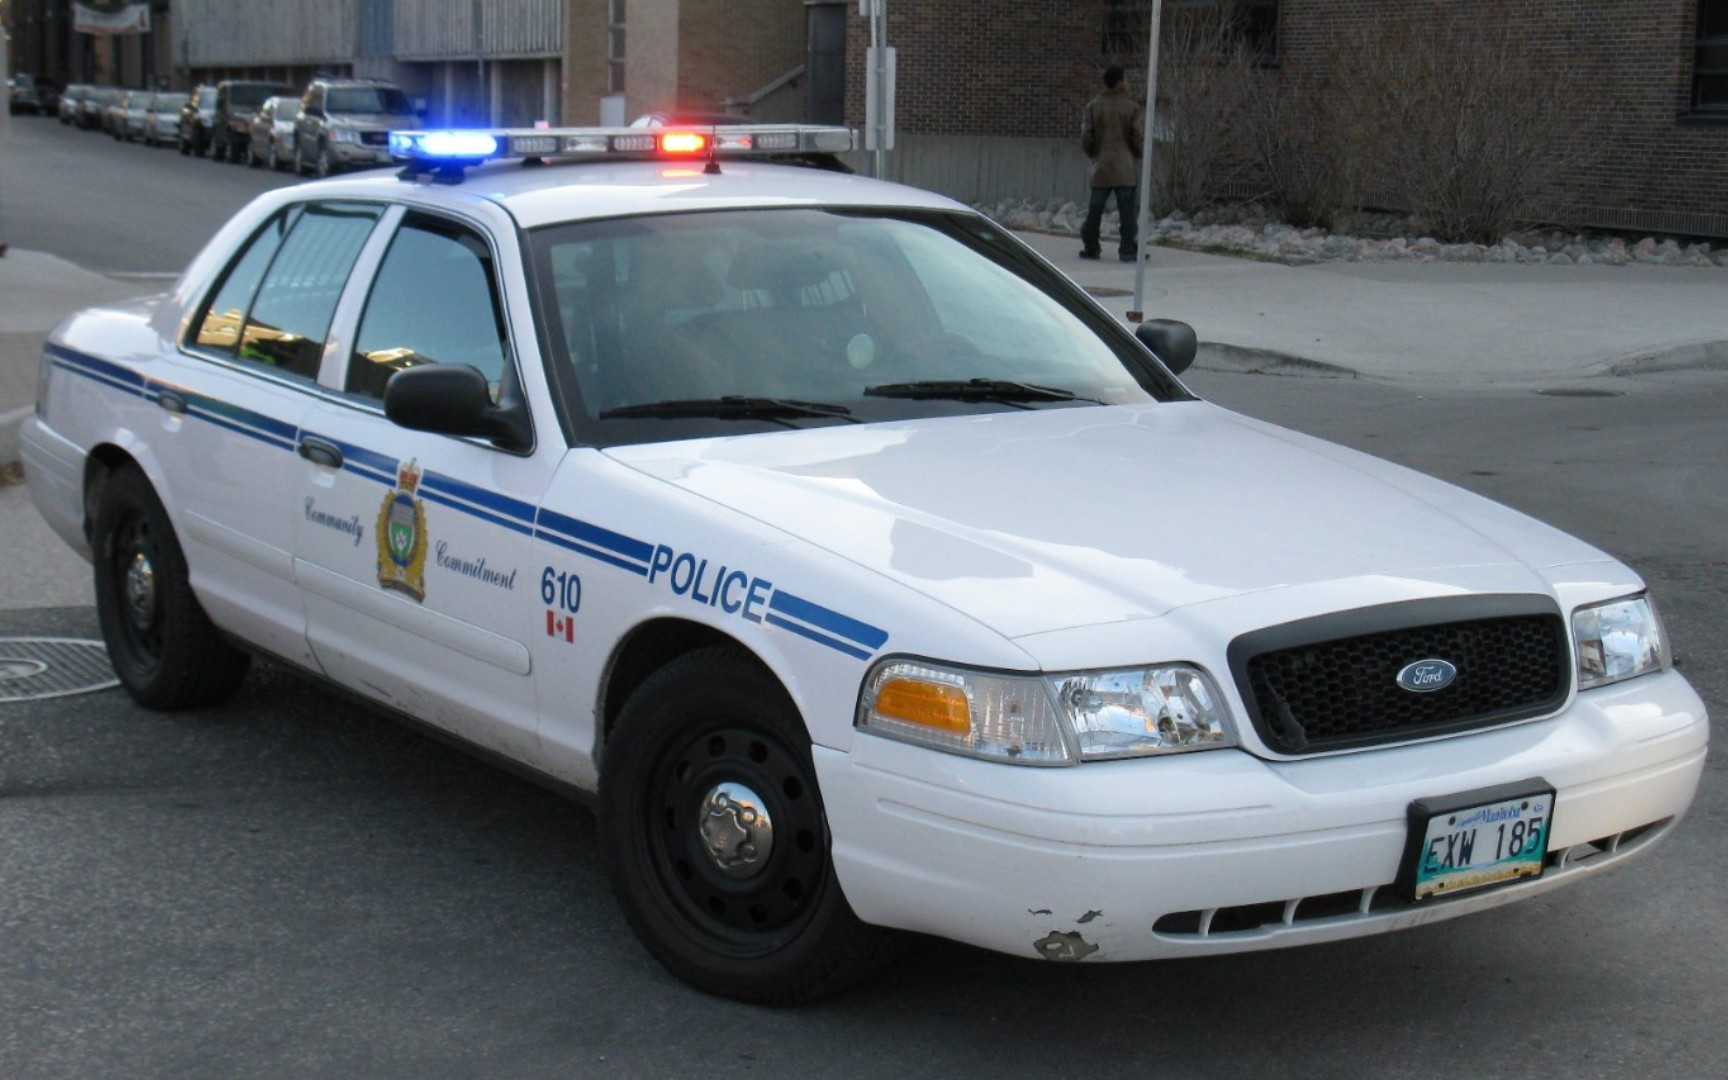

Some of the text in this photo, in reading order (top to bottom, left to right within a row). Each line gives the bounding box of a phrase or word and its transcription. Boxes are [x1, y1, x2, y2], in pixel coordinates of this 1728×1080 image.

[304, 496, 364, 548] Community
[435, 540, 517, 591] Commitment
[541, 565, 582, 614] 610
[648, 543, 773, 625] POLICE
[1412, 665, 1444, 685] Ford
[1481, 804, 1522, 824] Manitoba
[1424, 816, 1543, 874] EXW 185
